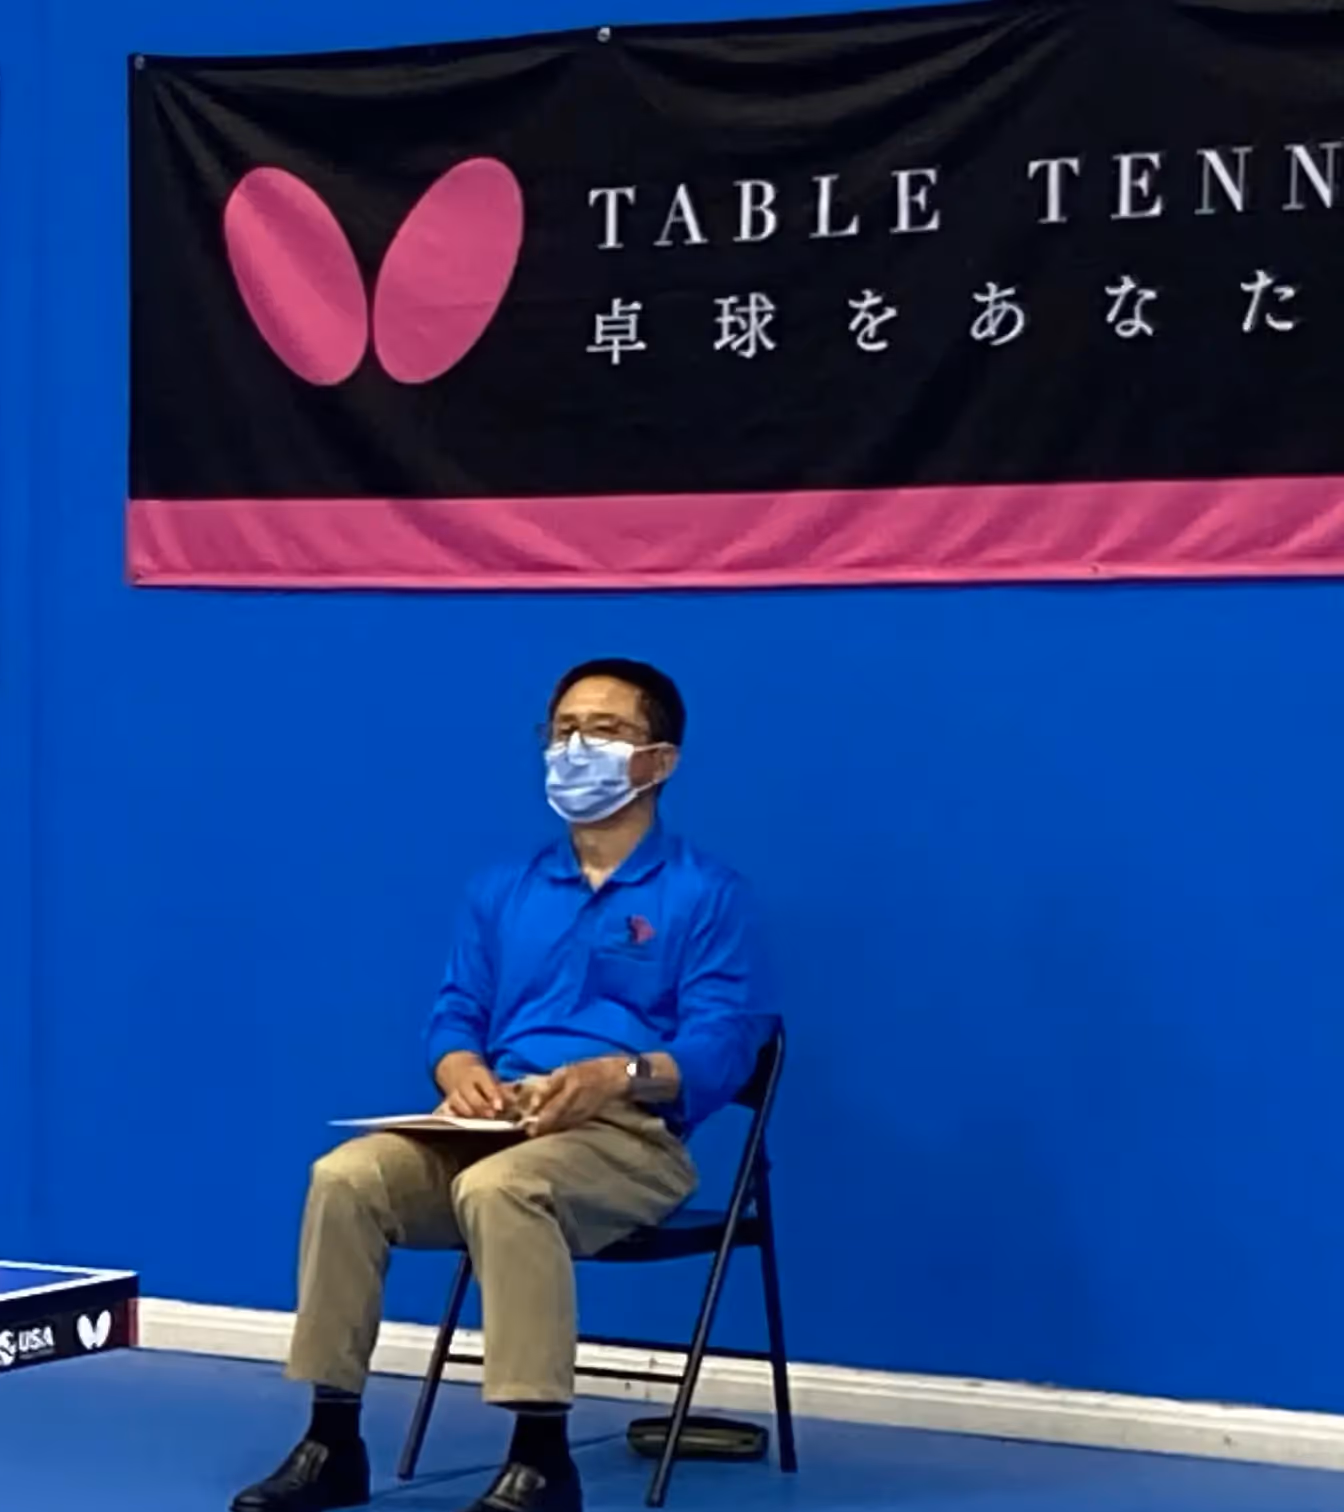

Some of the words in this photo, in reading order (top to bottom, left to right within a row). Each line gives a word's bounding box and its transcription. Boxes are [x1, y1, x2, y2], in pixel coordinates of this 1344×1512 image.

[588, 167, 942, 250] TABLE
[1027, 141, 1344, 223] TENN
[17, 1326, 55, 1351] USA
